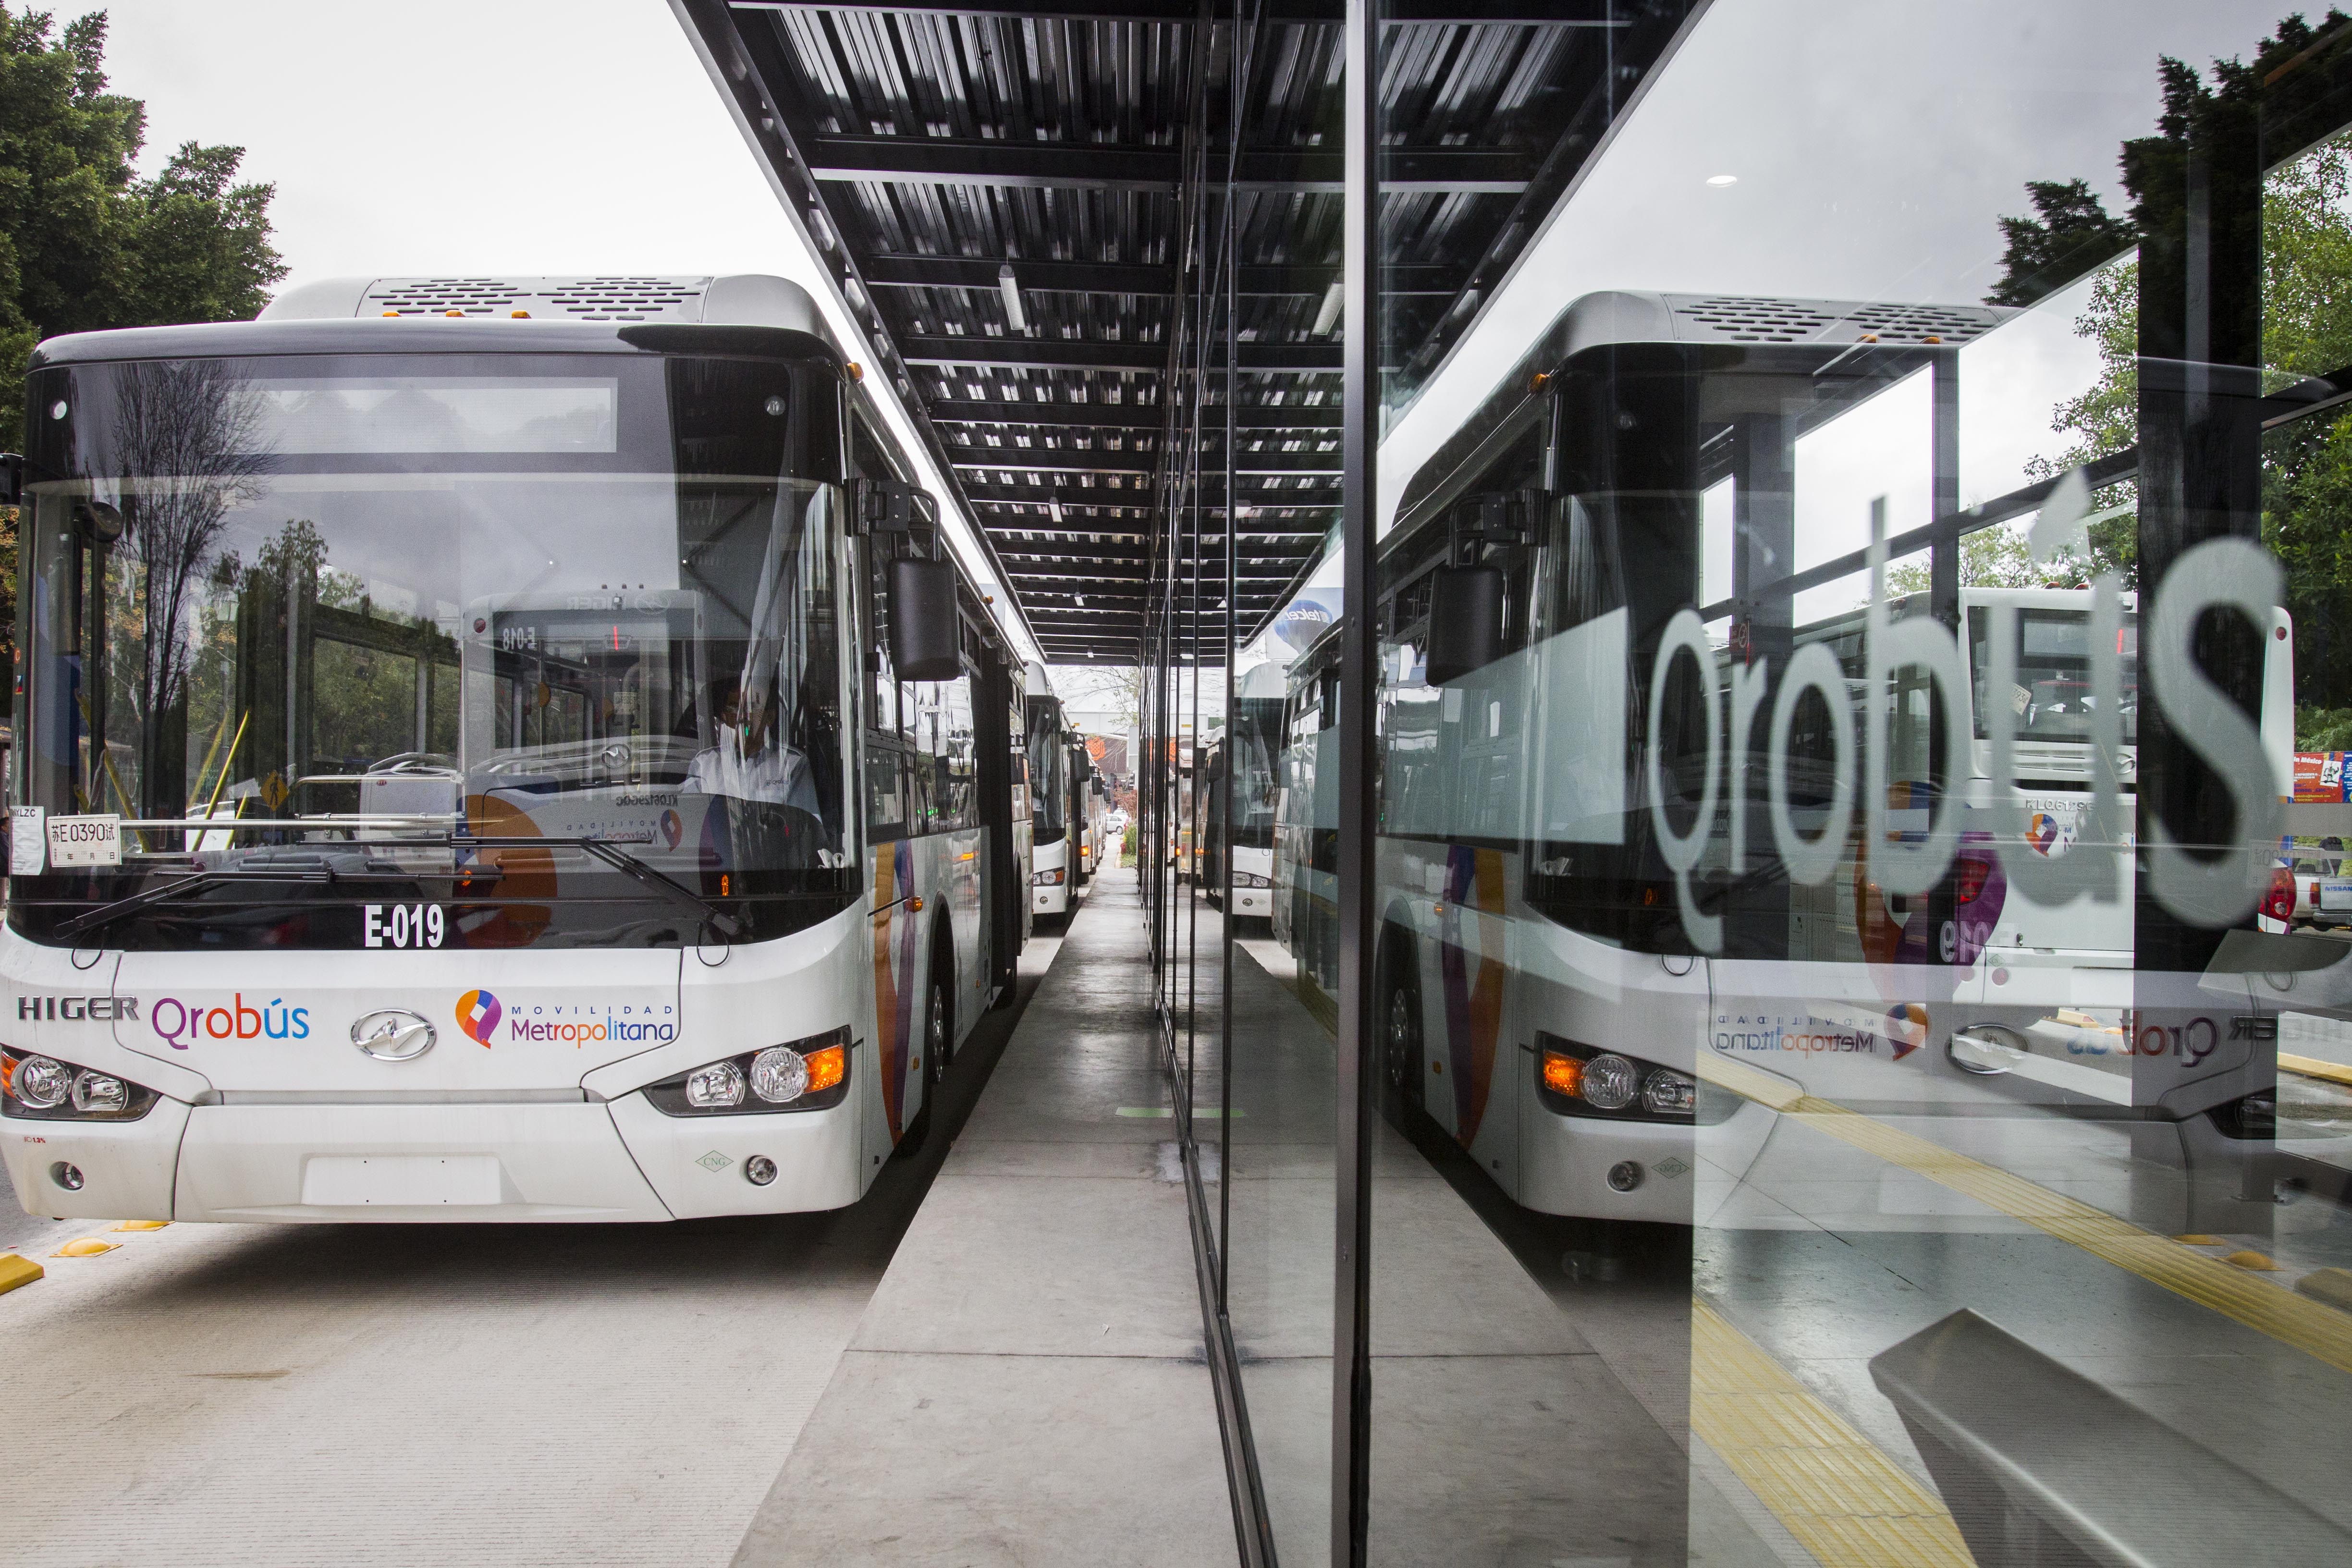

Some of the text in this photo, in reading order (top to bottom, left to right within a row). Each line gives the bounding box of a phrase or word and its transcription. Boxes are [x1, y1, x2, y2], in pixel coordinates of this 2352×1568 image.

[365, 904, 444, 948] E-019
[18, 995, 140, 1021] HIGER
[152, 992, 310, 1050] Qrobús
[512, 1005, 673, 1015] MOVILIDAD
[512, 1016, 673, 1049] Metropolitana
[703, 1157, 725, 1166] CNG
